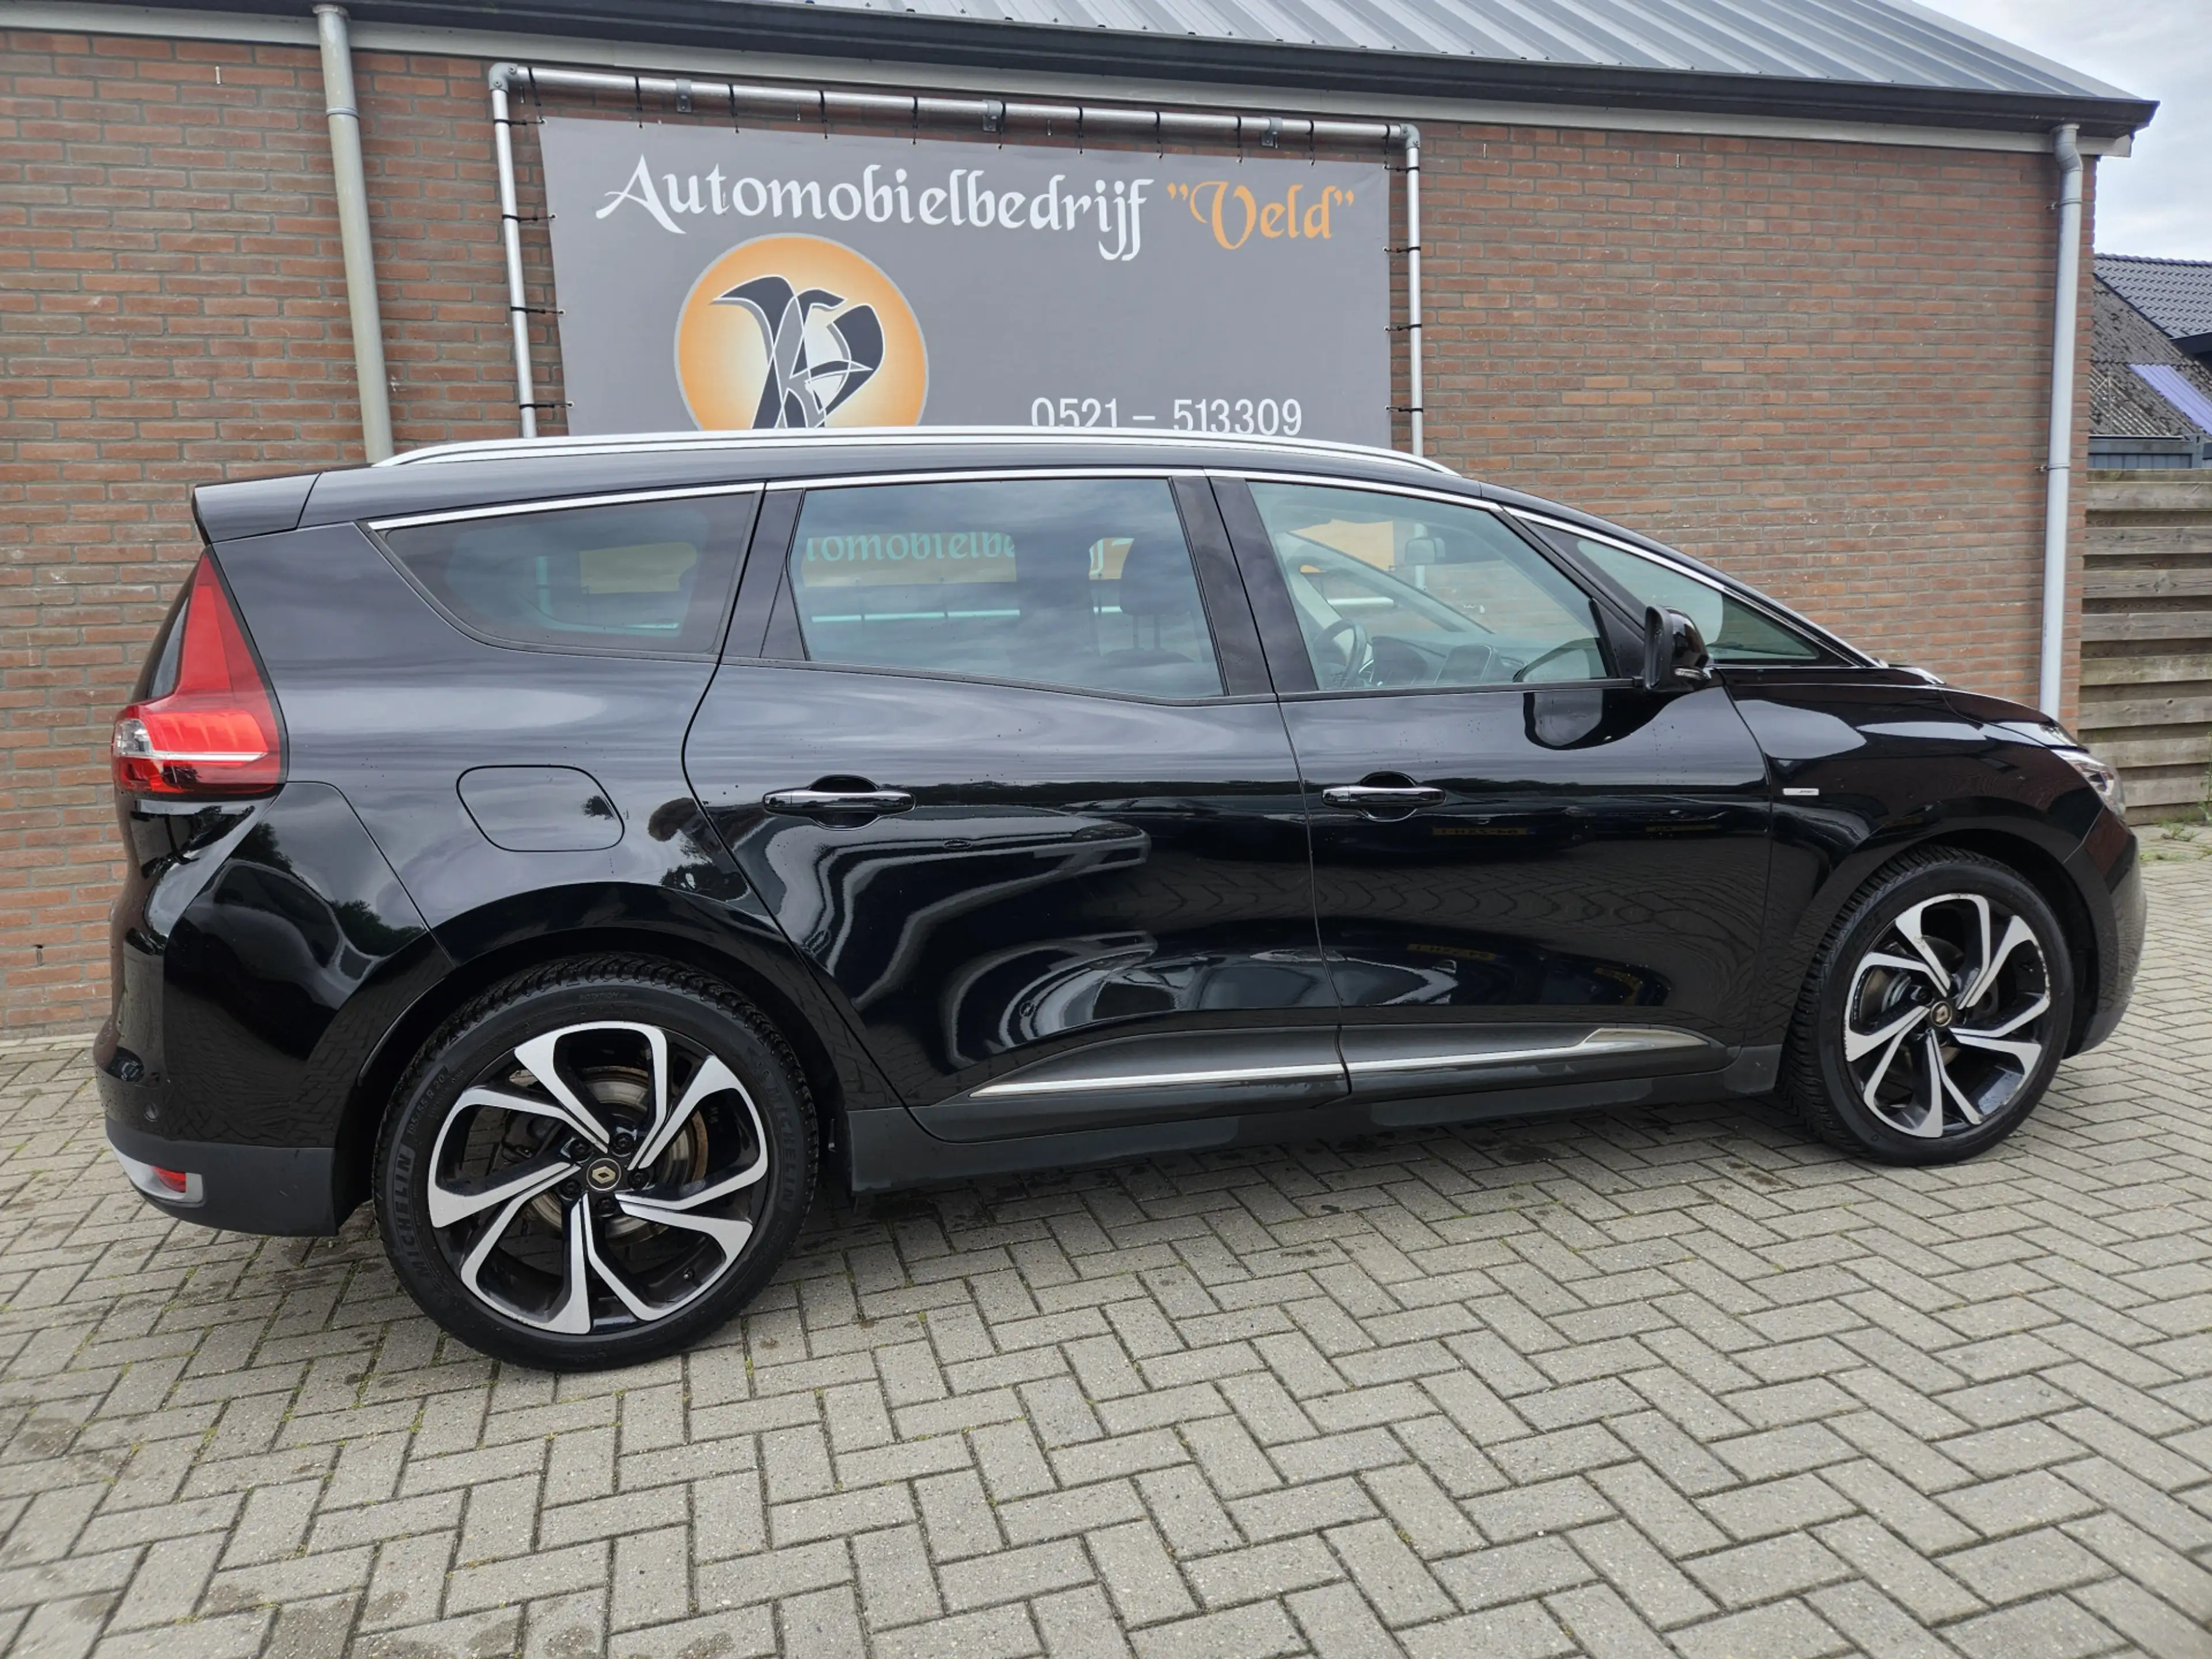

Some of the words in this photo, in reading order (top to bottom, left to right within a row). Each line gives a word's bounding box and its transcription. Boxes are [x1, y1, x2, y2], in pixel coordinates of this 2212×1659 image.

[595, 153, 1154, 262] Automobielbedrijf
[1031, 397, 1118, 427] 0521
[1172, 398, 1302, 436] 513309
[406, 1098, 429, 1135] 195/55
[426, 1089, 435, 1099] R
[433, 1074, 445, 1089] 20
[765, 1084, 798, 1204] MICHELIN
[394, 1153, 430, 1279] MICHELIN
